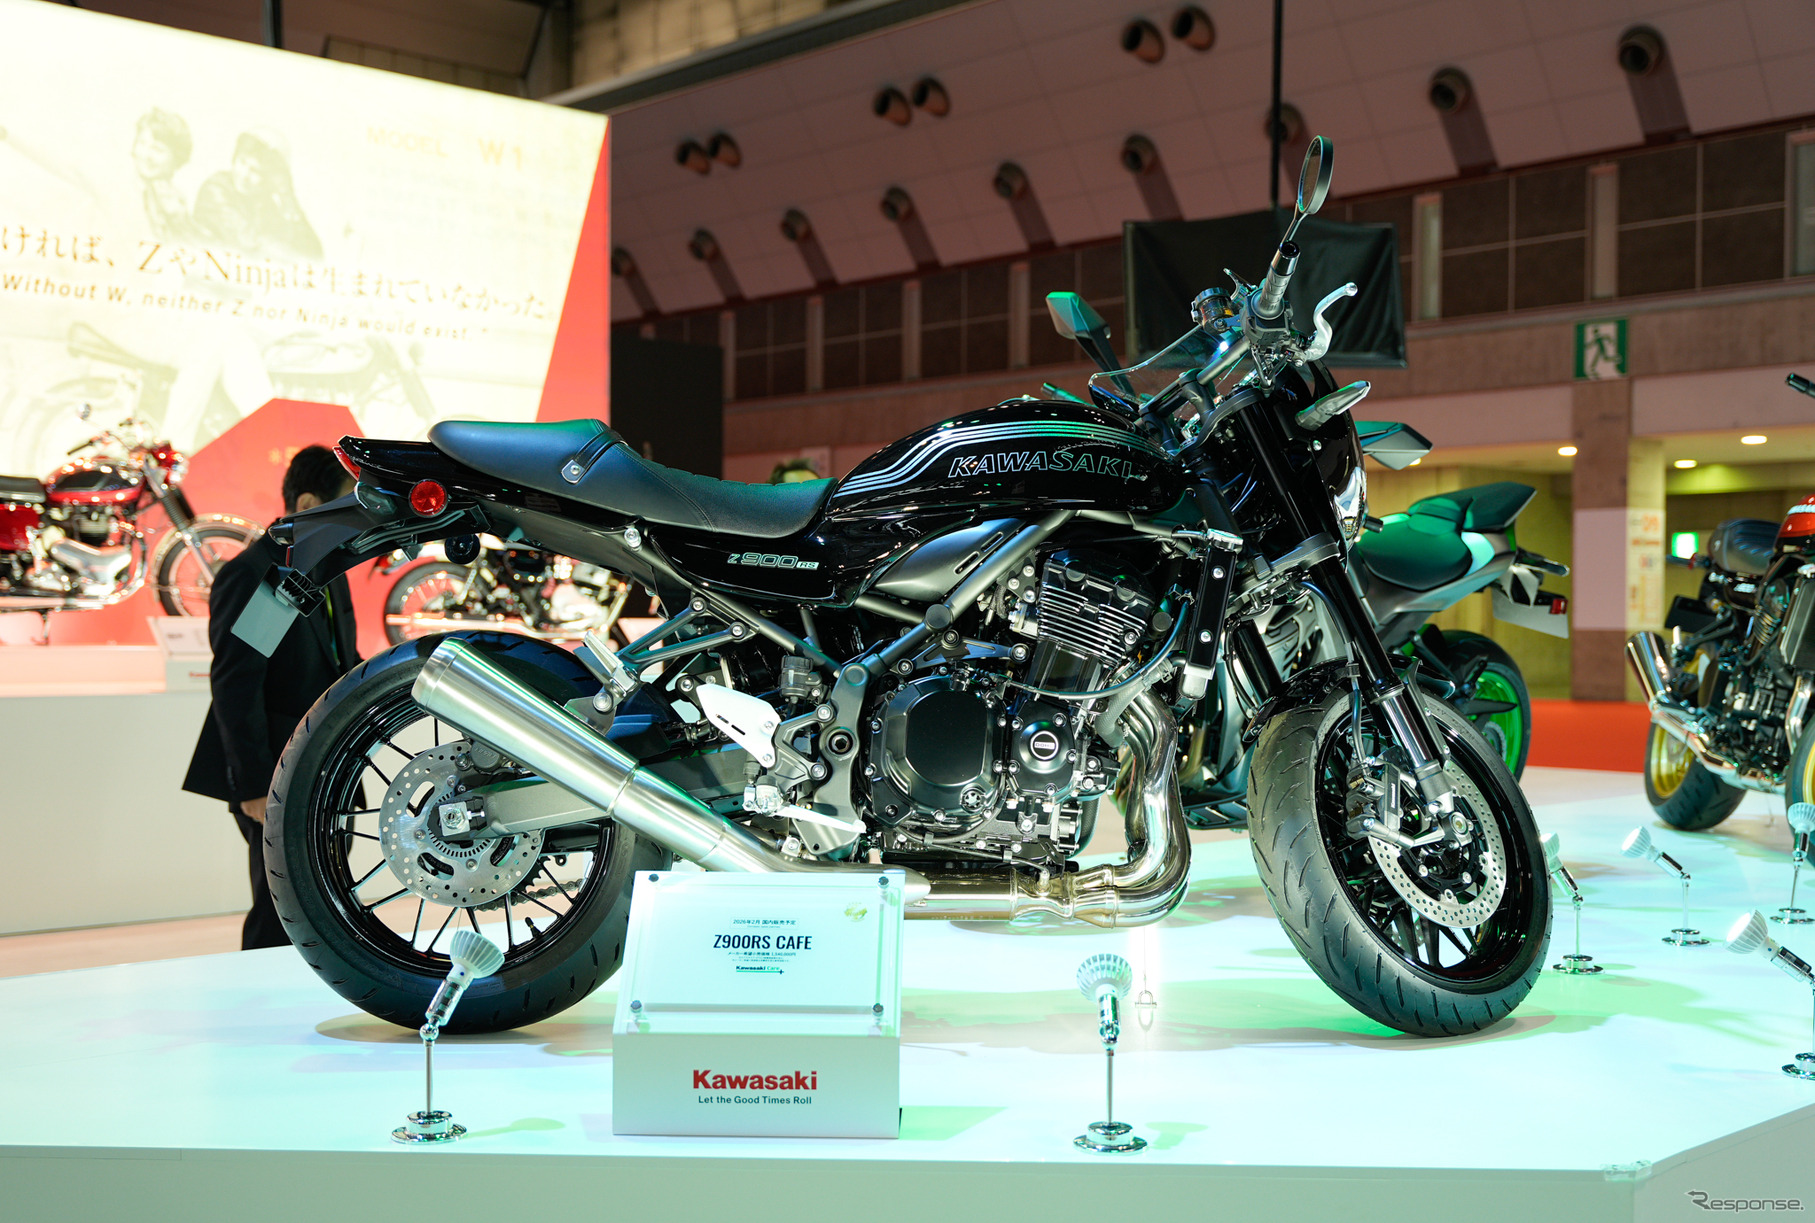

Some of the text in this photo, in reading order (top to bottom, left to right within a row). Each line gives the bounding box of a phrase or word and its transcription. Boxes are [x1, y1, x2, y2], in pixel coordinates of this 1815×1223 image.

[367, 126, 449, 159] MODEL
[2, 273, 97, 301] Without
[142, 292, 223, 314] neither
[231, 299, 246, 316] Z
[253, 305, 288, 321] nor
[297, 307, 349, 330] Ninja
[358, 314, 417, 336] would
[948, 451, 1132, 479] KAWASAKI
[713, 934, 813, 950] Z900RS CAFE
[693, 1070, 817, 1090] Kawasaki
[698, 1096, 812, 1104] Let the Good Times Roll
